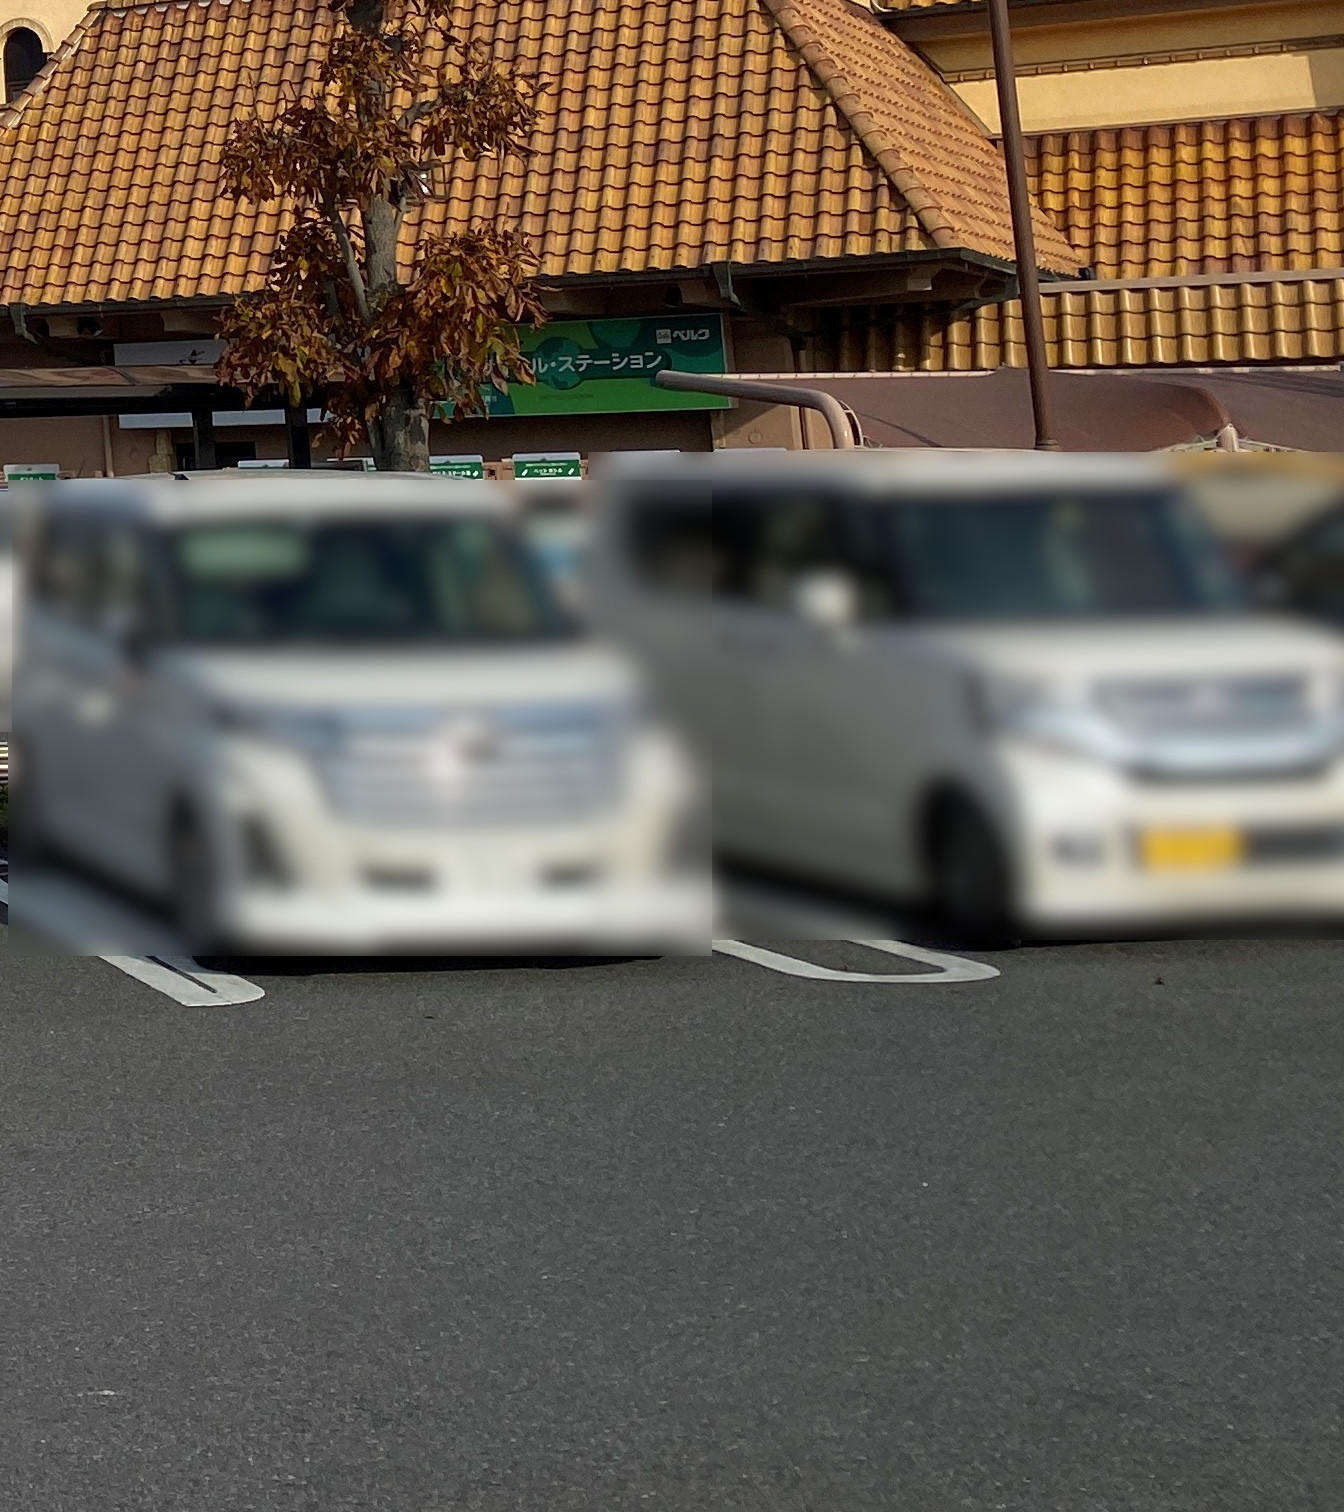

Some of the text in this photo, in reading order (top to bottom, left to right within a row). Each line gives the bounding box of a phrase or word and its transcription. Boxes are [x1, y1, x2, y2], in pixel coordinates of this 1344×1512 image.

[483, 351, 663, 378] ル・ステーション
